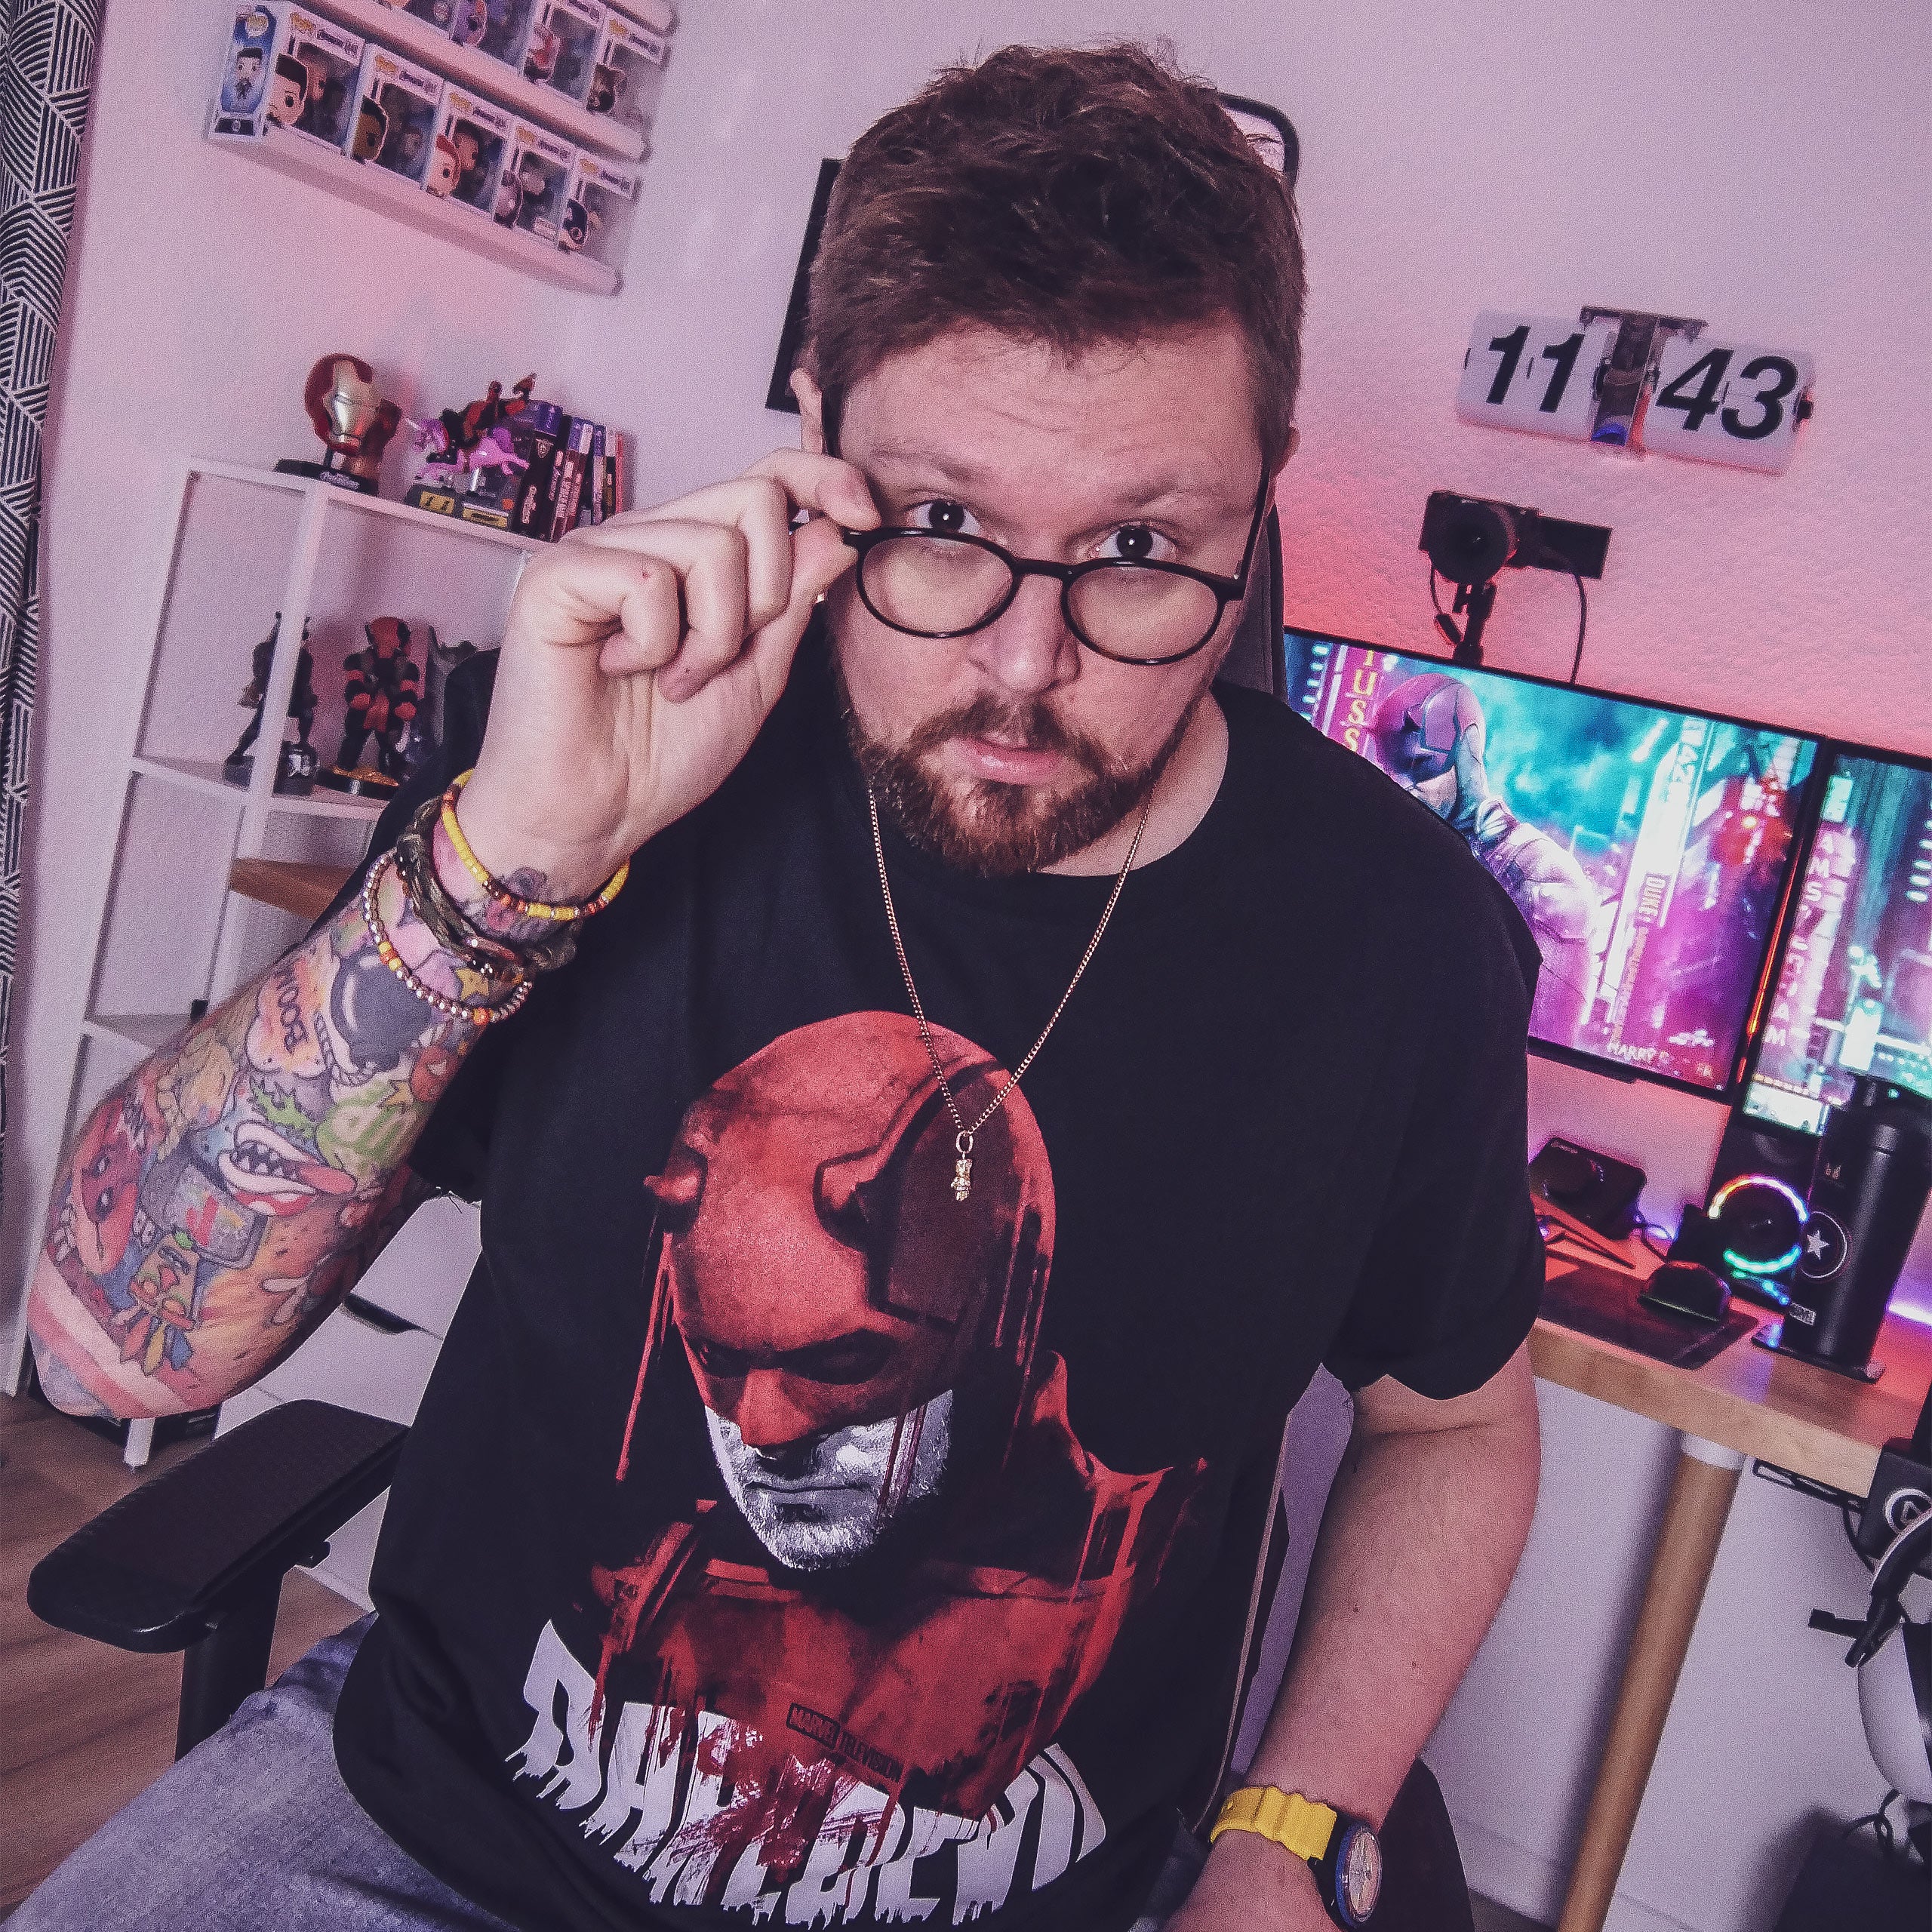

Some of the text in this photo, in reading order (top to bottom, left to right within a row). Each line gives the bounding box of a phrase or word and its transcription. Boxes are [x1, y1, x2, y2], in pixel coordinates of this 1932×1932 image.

[1486, 325, 1798, 439] 11 43
[787, 1704, 904, 1783] MARVEL TELEVISION
